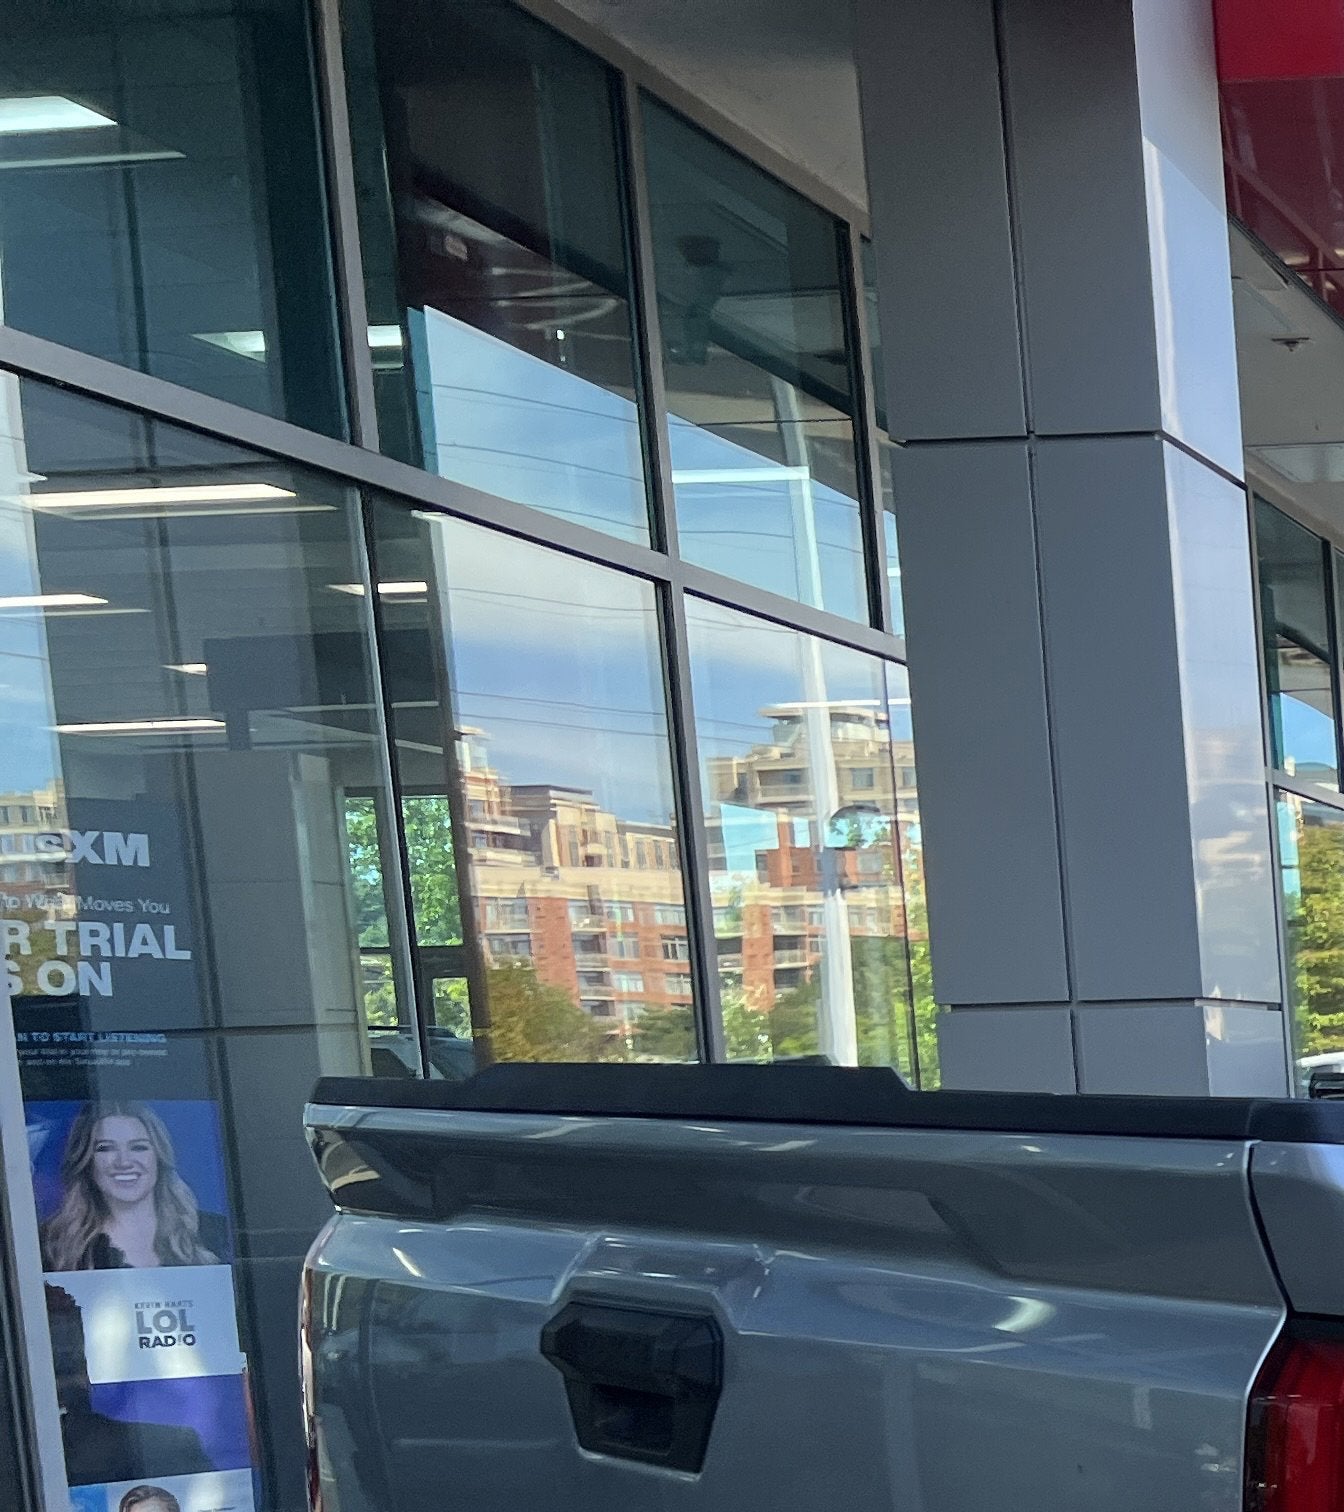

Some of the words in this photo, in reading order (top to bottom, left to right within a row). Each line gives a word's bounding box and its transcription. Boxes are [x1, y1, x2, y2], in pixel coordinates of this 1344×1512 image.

[78, 896, 134, 913] Moves
[138, 898, 170, 914] You
[44, 920, 192, 960] TRIAL
[37, 959, 113, 997] ON
[136, 1309, 195, 1334] LOL
